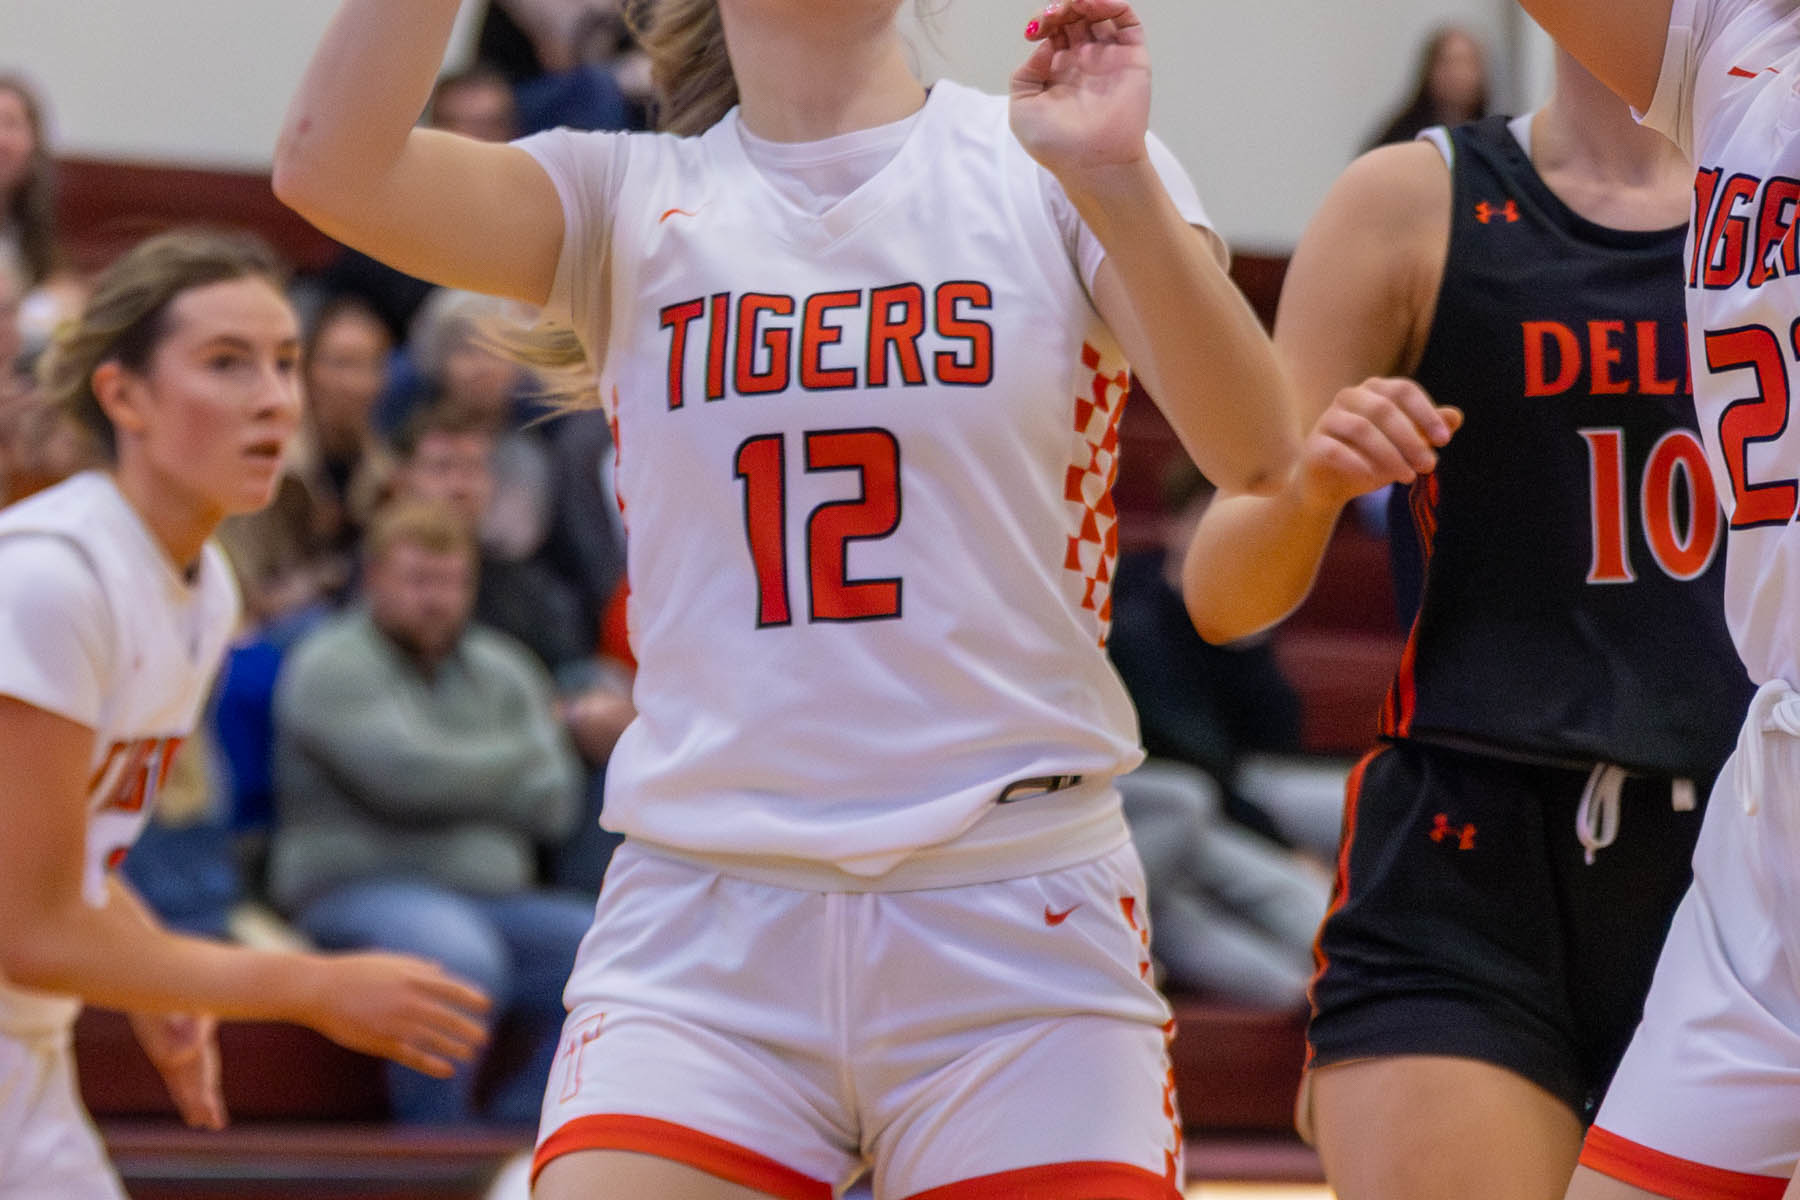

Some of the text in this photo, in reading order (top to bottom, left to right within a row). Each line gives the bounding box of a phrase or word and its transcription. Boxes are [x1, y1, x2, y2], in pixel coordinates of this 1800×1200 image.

[660, 279, 995, 413] TIGERS
[1520, 319, 1694, 398] DEL
[732, 425, 904, 631] 12
[1576, 426, 1722, 584] 10
